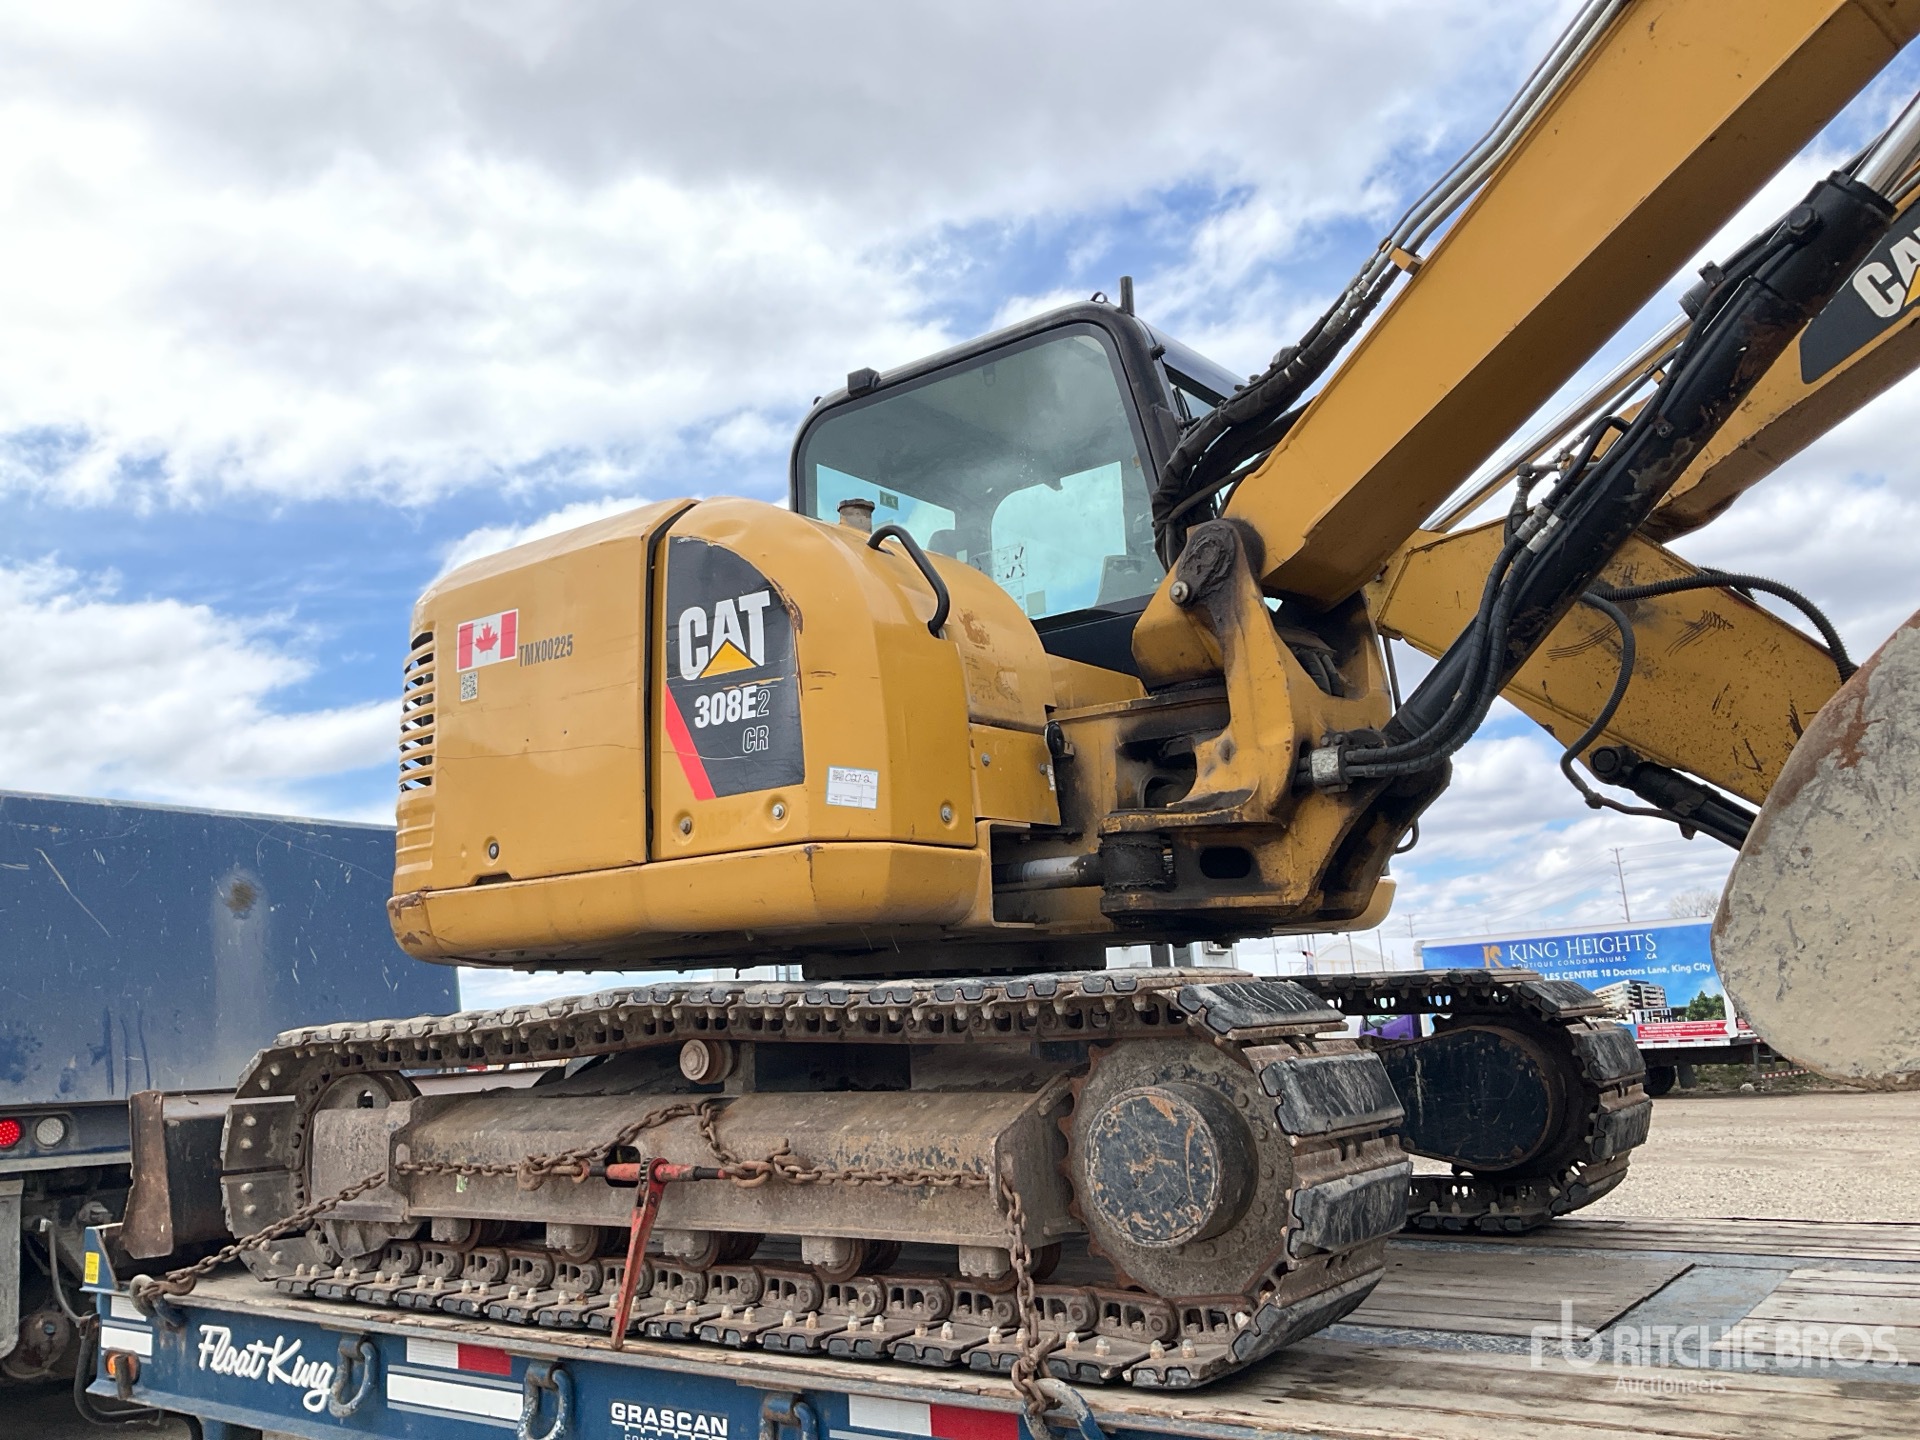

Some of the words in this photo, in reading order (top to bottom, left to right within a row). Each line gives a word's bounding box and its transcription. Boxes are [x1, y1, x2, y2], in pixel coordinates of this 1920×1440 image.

[1852, 226, 1920, 318] CA
[519, 634, 573, 667] TMX00225
[679, 590, 771, 681] CAT
[743, 725, 769, 753] CR
[1509, 941, 1559, 963] KING
[1566, 933, 1657, 959] HEIGHTS
[1557, 955, 1627, 966] CONDOMINIUMS
[1562, 970, 1599, 980] CENTRE
[1600, 969, 1611, 978] 18
[1613, 966, 1645, 977] Doctors
[1671, 963, 1692, 974] King
[1693, 962, 1711, 973] City
[611, 1402, 728, 1436] GRASCAN
